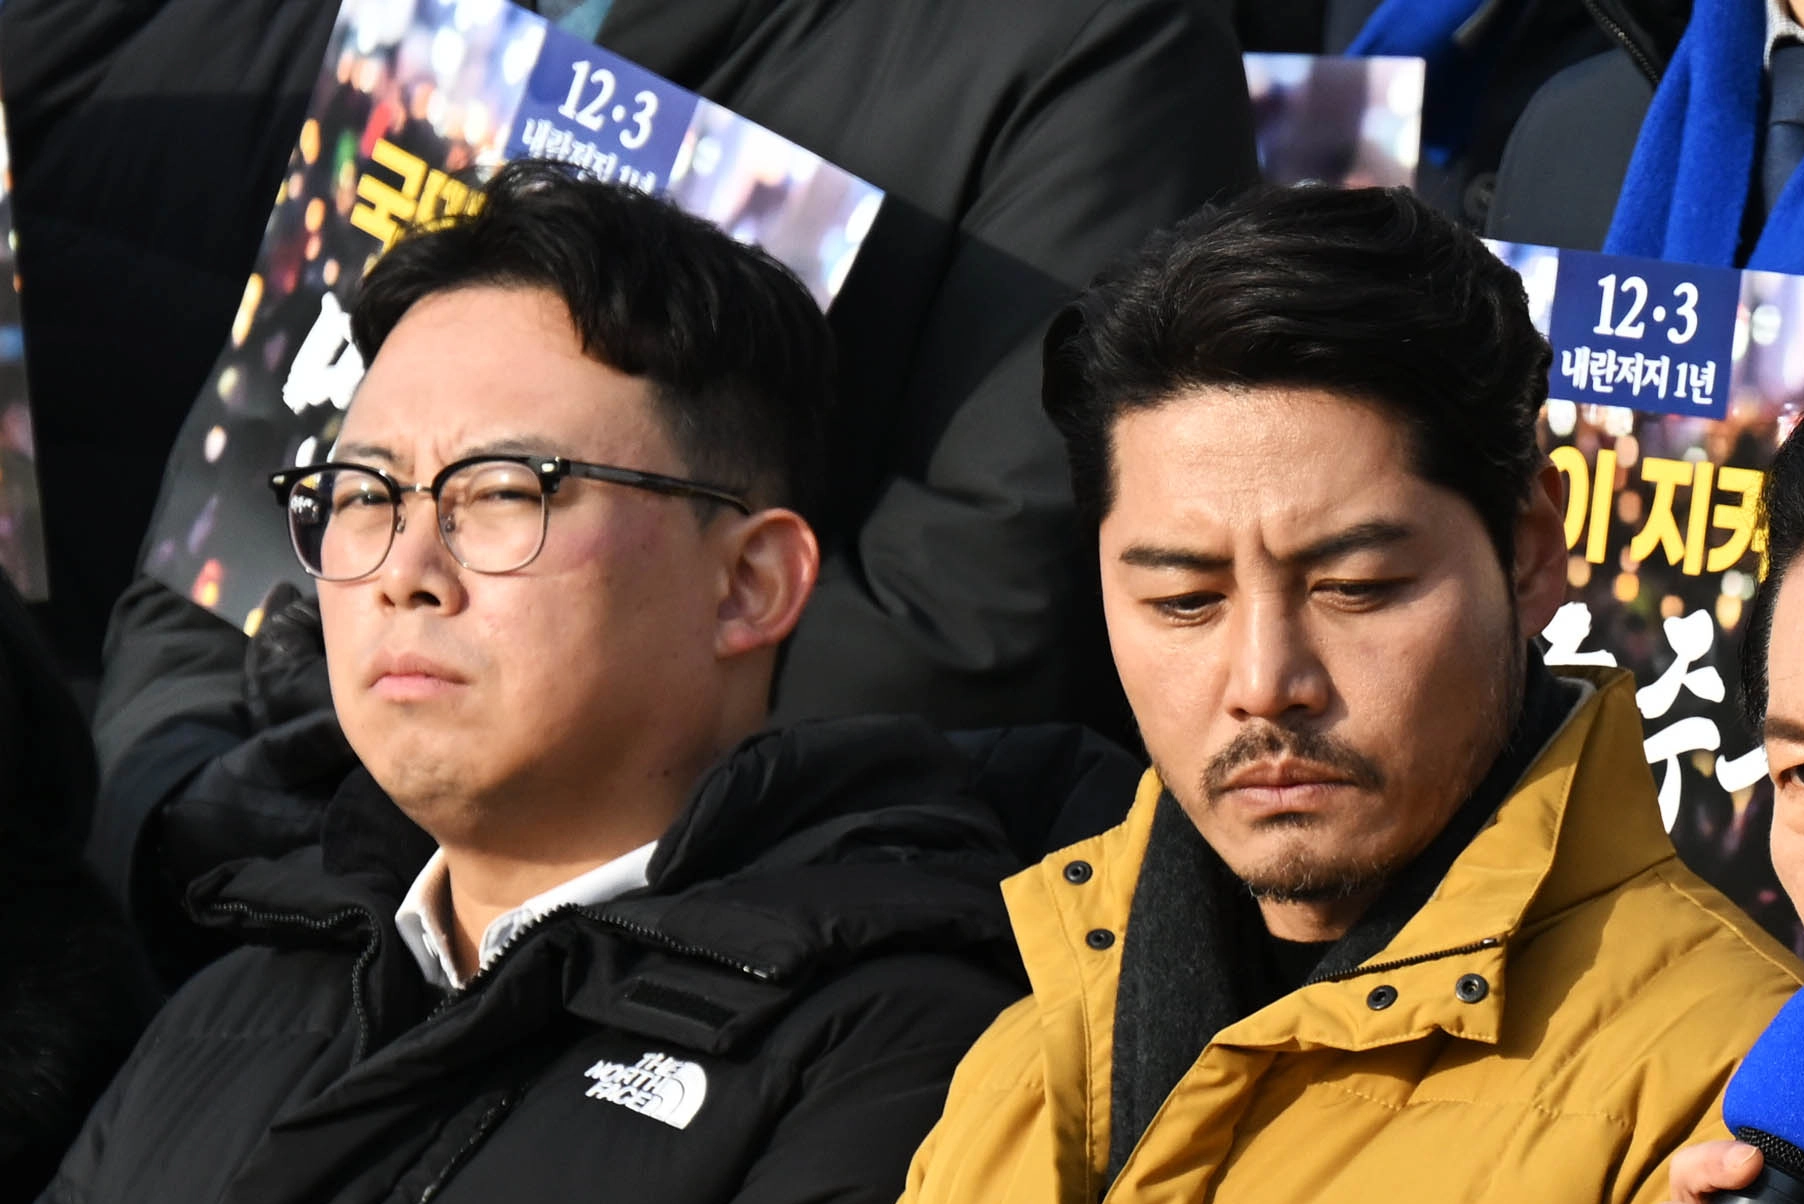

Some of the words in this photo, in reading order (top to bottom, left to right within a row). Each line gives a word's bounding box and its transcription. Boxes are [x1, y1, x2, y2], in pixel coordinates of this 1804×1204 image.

[1559, 345, 1672, 398] 내란저지
[1674, 360, 1716, 406] 1년
[584, 1060, 666, 1094] NORTH
[635, 1052, 684, 1076] THE
[585, 1082, 652, 1112] FACE
